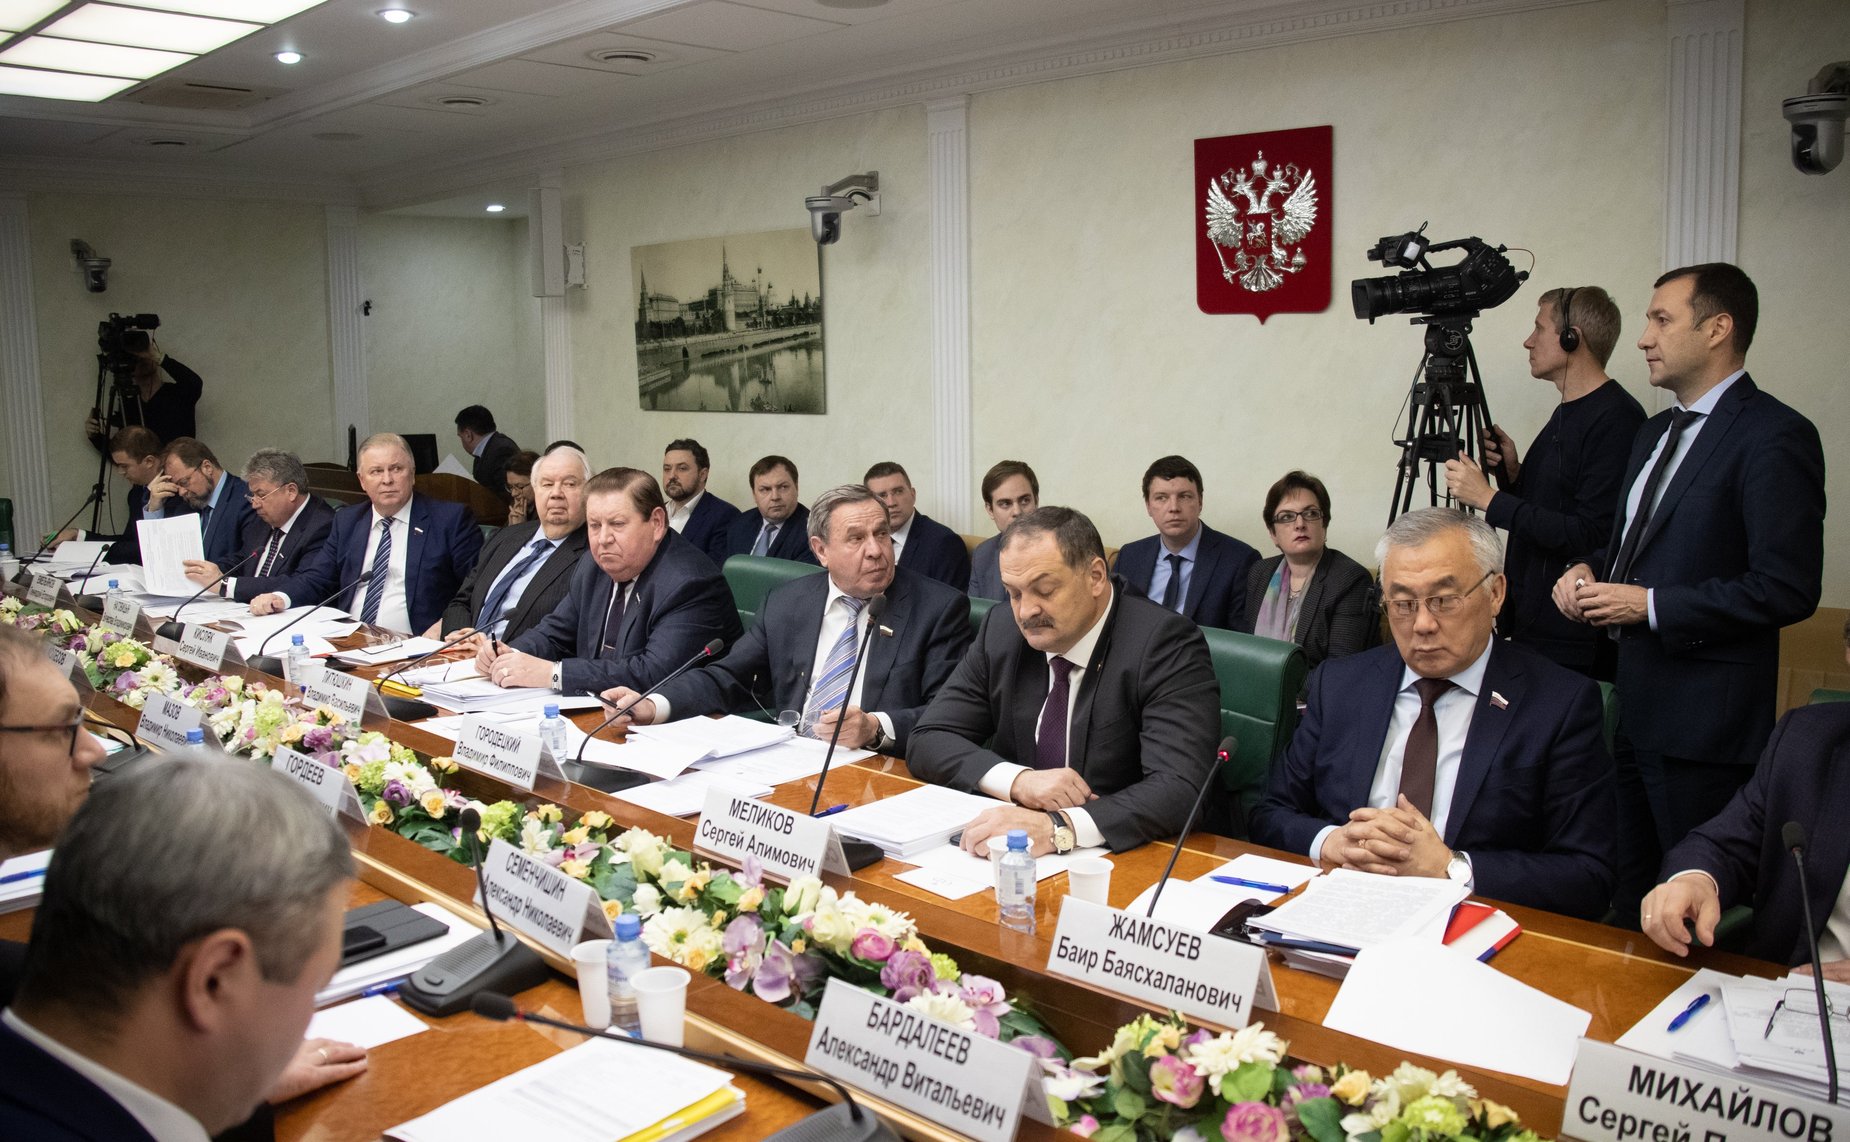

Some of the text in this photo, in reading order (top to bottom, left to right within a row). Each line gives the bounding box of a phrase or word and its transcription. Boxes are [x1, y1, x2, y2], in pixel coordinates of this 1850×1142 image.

[180, 640, 219, 664] Сергей Иванович
[162, 700, 182, 720] МАЗОВ
[306, 685, 331, 705] Владимир
[140, 714, 187, 746] Владимир Николаев
[475, 725, 522, 754] ГОРОДЕЦКИЙ
[285, 754, 325, 785] ГОРДЕЕВ
[457, 741, 532, 782] Владимир Филиппович
[728, 798, 795, 835] МЕЛИКОВ
[701, 819, 816, 874] Сергей Алимович
[505, 851, 568, 902] СЕМЕНЧИШИН
[522, 896, 575, 944] Николаевич
[1108, 913, 1202, 961] ЖАМСУЕВ
[1056, 935, 1243, 1014] Баир Баясхаланович
[866, 1001, 972, 1066] БАРДАЛЕЕВ
[815, 1026, 1007, 1130] Александр Витальевич
[1579, 1096, 1692, 1142] Сергей
[1628, 1064, 1834, 1142] МИХАЙЛОВ
